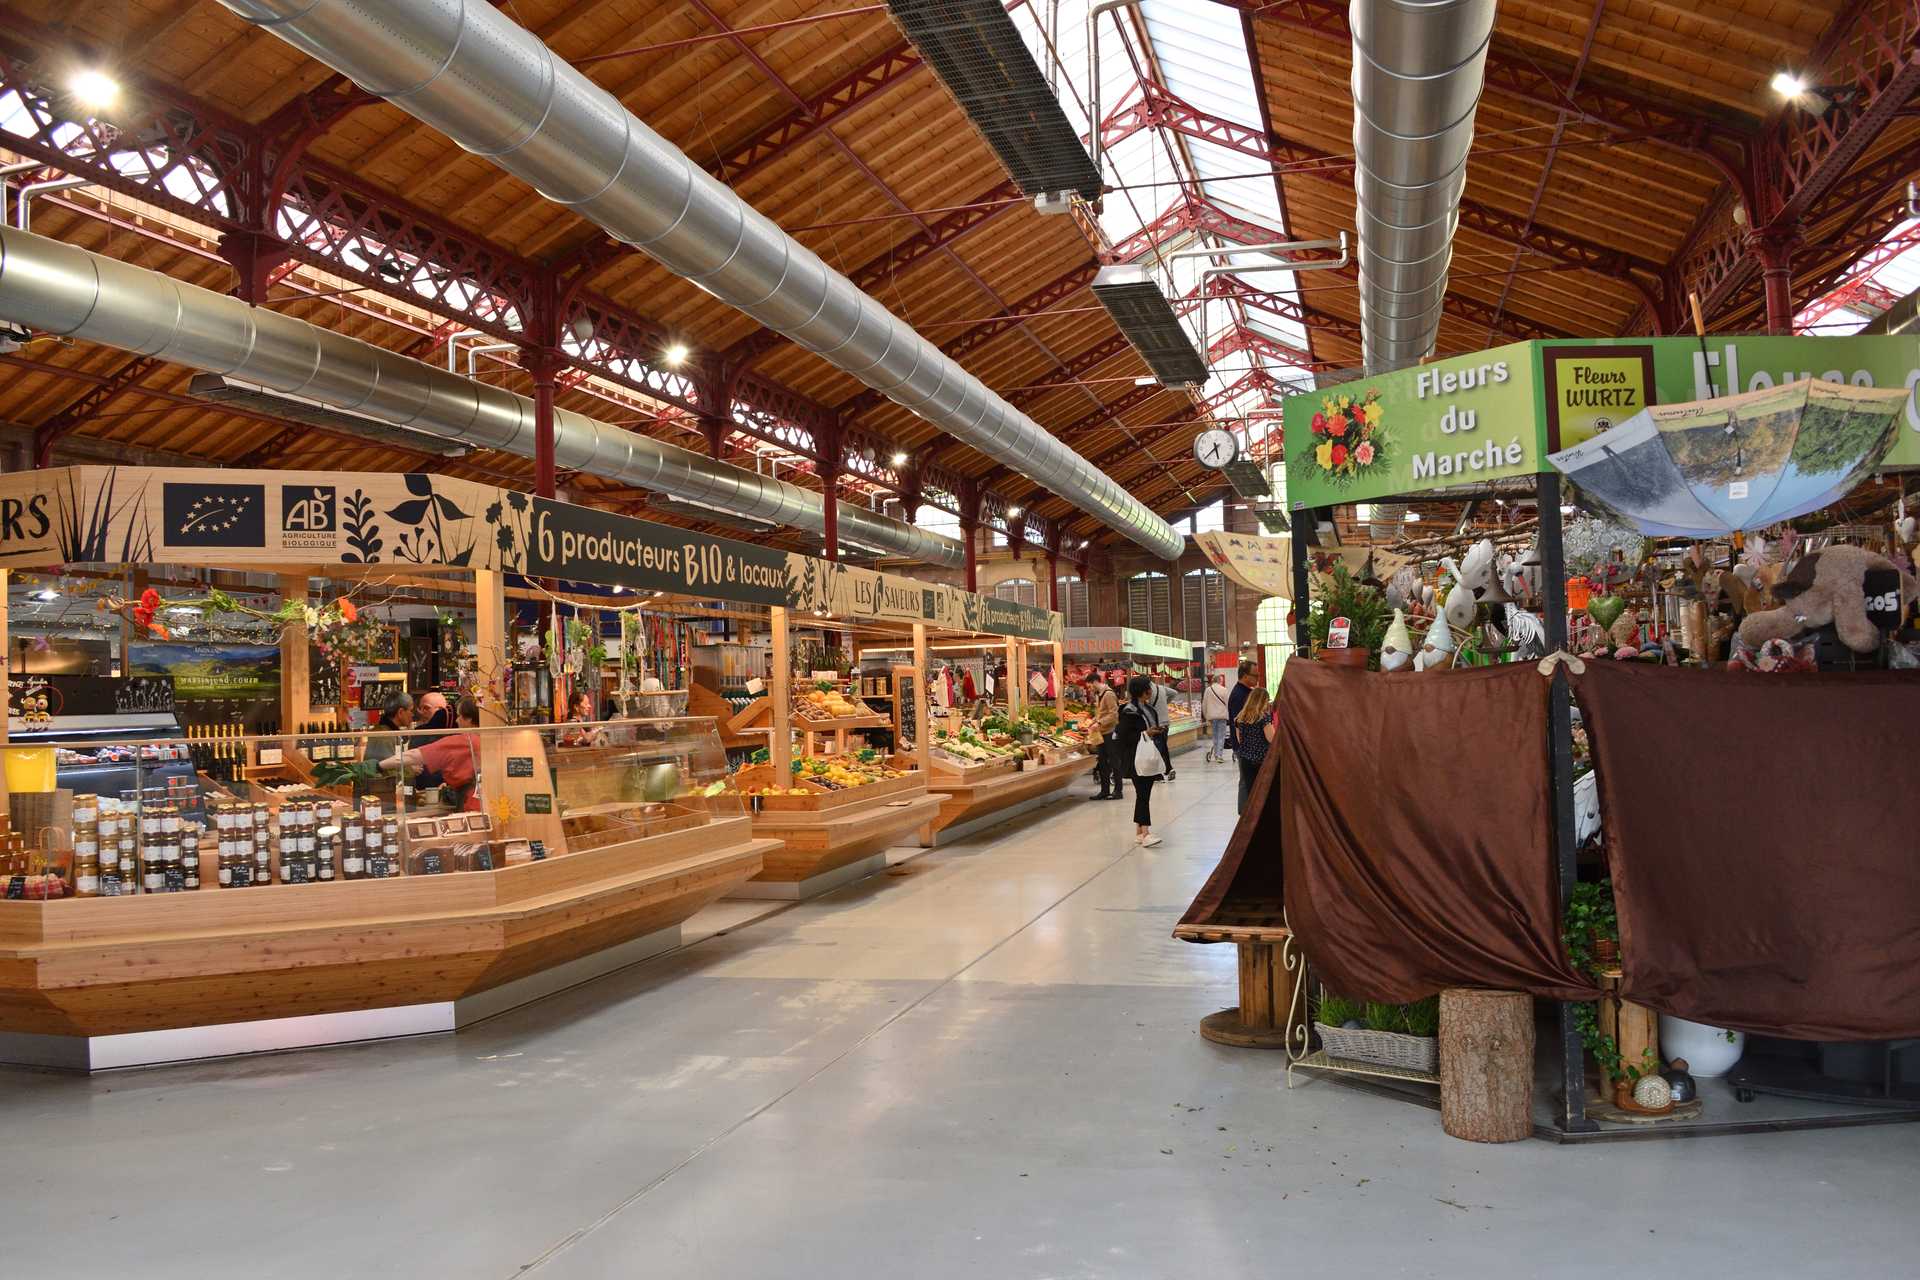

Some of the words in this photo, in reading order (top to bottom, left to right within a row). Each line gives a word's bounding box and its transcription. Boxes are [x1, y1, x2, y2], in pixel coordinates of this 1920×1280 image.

[1417, 361, 1509, 399] Fleurs
[1573, 366, 1626, 386] Fleurs
[1566, 388, 1636, 408] WURTZ
[1440, 405, 1476, 434] du
[1412, 436, 1522, 480] Marché
[286, 499, 329, 530] AB
[538, 511, 555, 562] 6
[561, 530, 680, 574] producteurs
[683, 544, 722, 586] BIO
[726, 555, 736, 582] &
[740, 557, 786, 589] locaux
[854, 579, 872, 605] LES
[884, 585, 920, 612] SAVEURS
